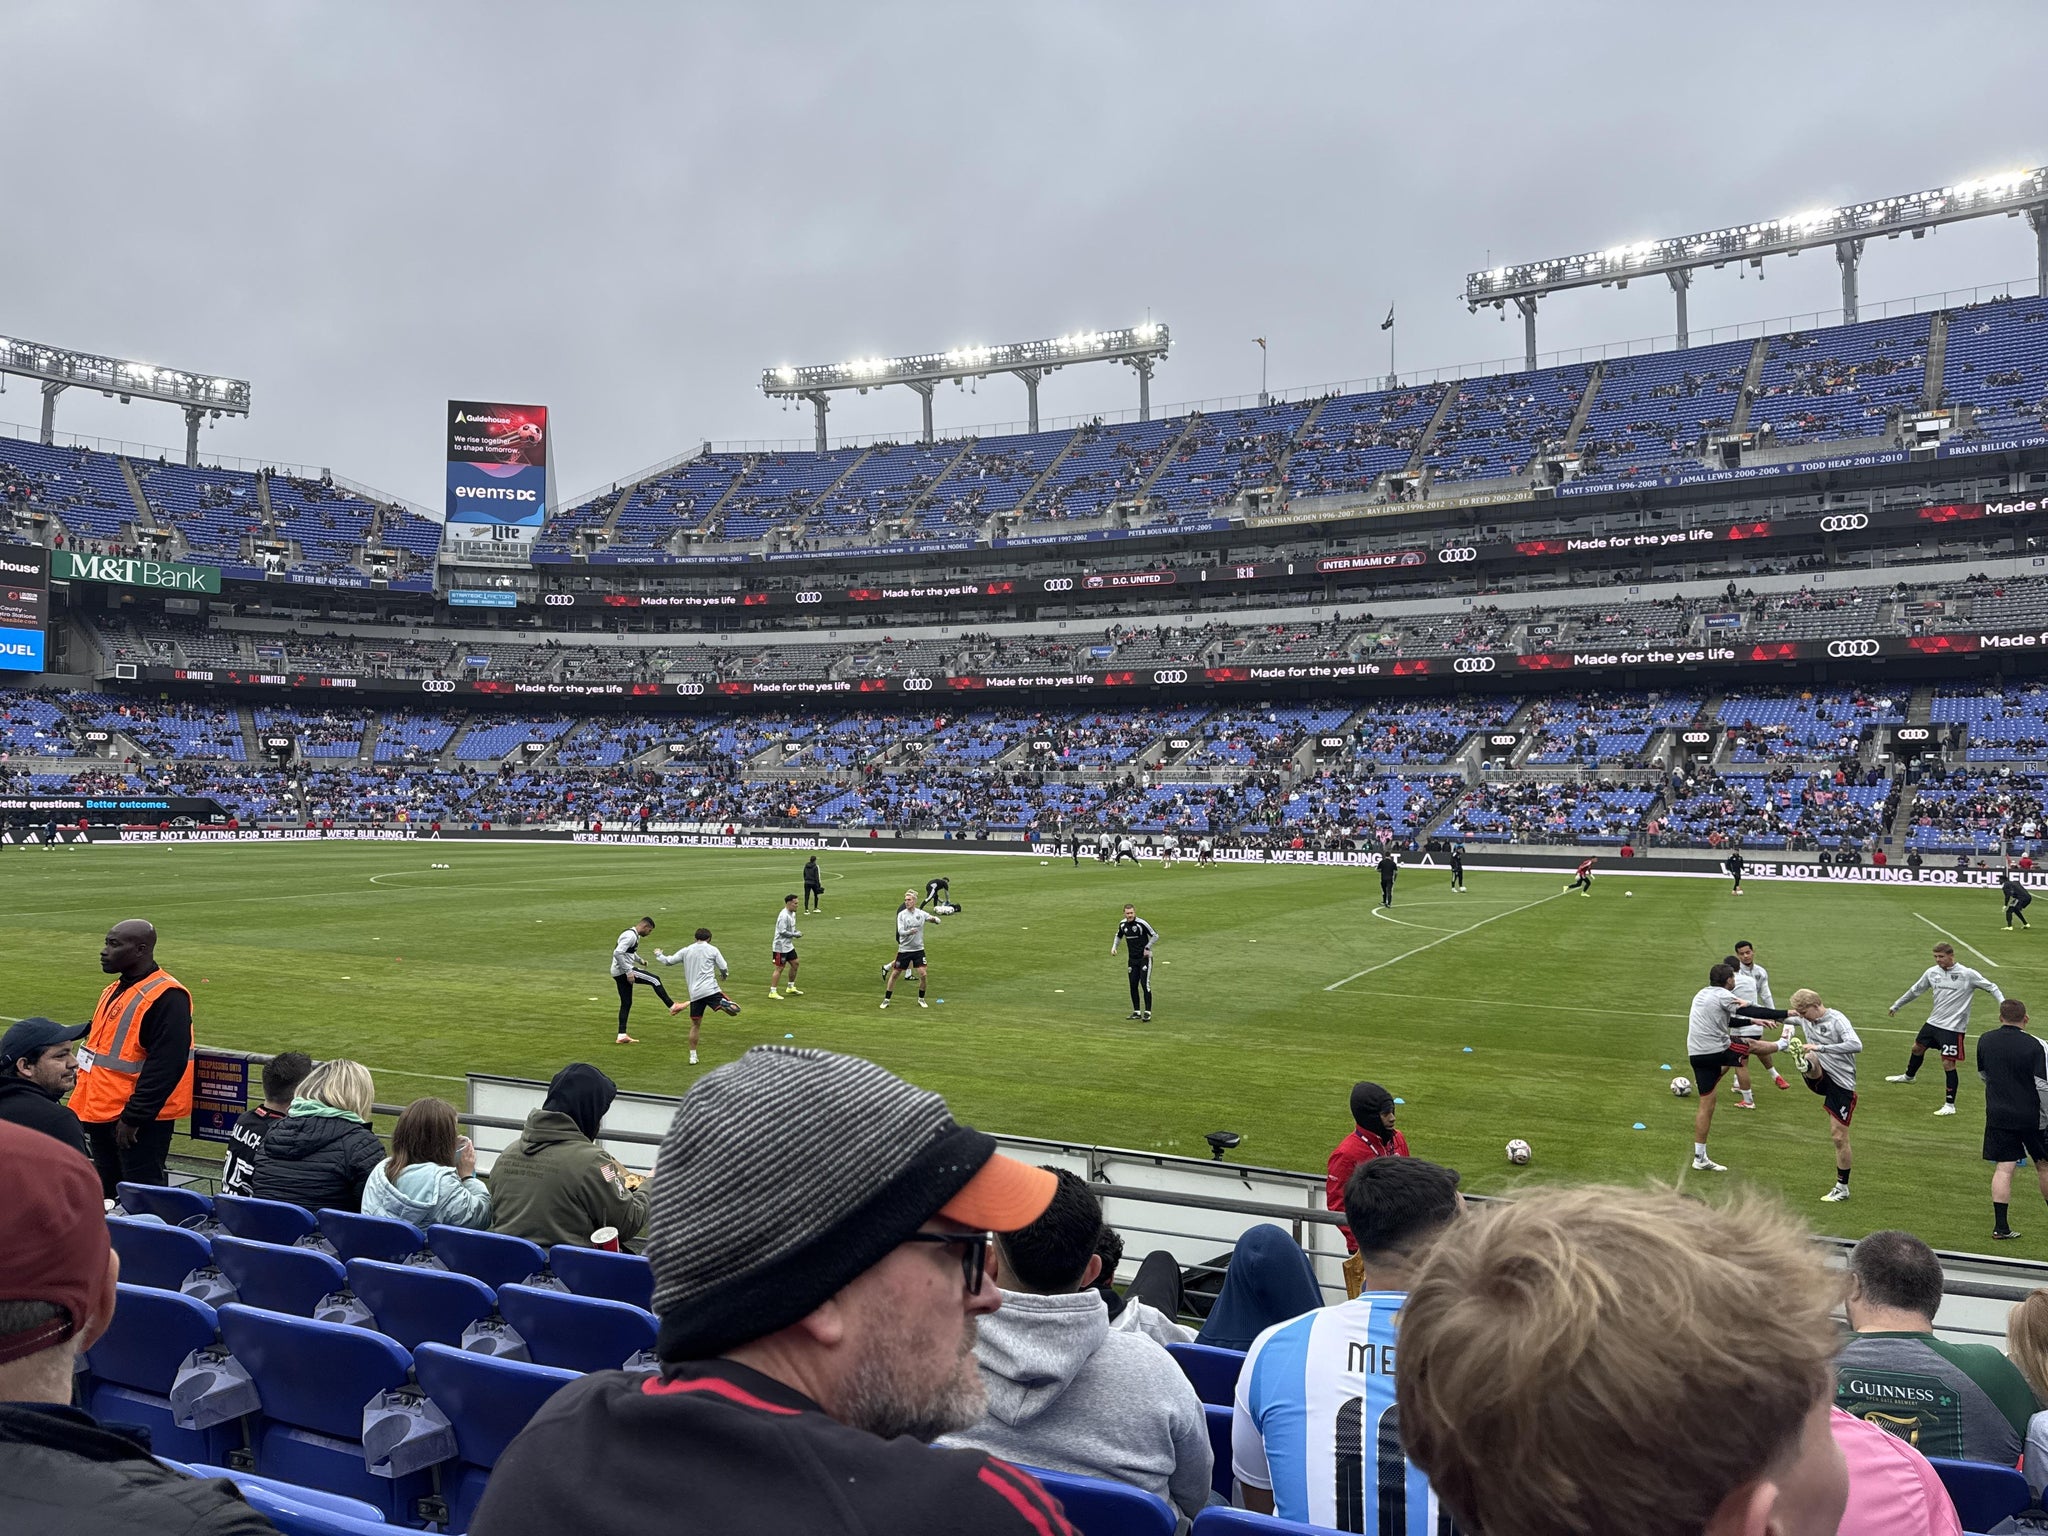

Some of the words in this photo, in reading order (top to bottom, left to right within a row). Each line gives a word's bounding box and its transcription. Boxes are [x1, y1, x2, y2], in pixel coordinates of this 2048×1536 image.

[466, 415, 510, 424] Guidehouse
[1950, 445, 1978, 455] BRIAN
[1981, 440, 2018, 452] BILLICK
[1801, 462, 1826, 471] TODD
[1828, 459, 1852, 469] HEAP
[1854, 454, 1903, 465] 2001-2010
[1679, 476, 1706, 486] JAMAL
[1708, 472, 1732, 481] LEWIS
[1734, 467, 1780, 478] 2000-2006
[1562, 487, 1583, 495] MATT
[1584, 484, 1614, 493] STOVER
[1616, 480, 1658, 490] 1996-2008
[516, 490, 536, 501] DC
[1492, 492, 1533, 502] 2002-2012
[1382, 505, 1404, 514] LEWIS
[1406, 501, 1445, 511] 1996-2012
[1985, 500, 2036, 515] Made
[1257, 516, 1292, 526] JONATHAN
[1293, 514, 1316, 523] OGDEN
[1318, 510, 1354, 520] 1996-2007
[491, 524, 520, 541] Lite
[1147, 527, 1179, 536] BOULWARE
[1180, 524, 1212, 533] 1997-2005
[1568, 540, 1607, 550] Made
[1610, 537, 1631, 547] for
[1634, 535, 1658, 545] the
[1661, 533, 1686, 544] yes
[1690, 529, 1713, 540] life
[70, 553, 140, 583] M&T
[144, 562, 206, 591] Bank
[1130, 575, 1160, 583] UNITED
[1323, 560, 1350, 569] INTER
[1352, 558, 1381, 568] MIAMI
[1383, 556, 1396, 565] CF
[882, 589, 909, 598] Made
[911, 588, 925, 596] for
[926, 587, 942, 596] the
[944, 588, 961, 597] yes
[962, 586, 978, 594] life
[670, 597, 684, 605] for
[685, 597, 702, 605] the
[703, 598, 719, 607] yes
[1981, 634, 2036, 647] Made
[1574, 654, 1616, 665] Made
[1620, 652, 1643, 663] for
[1647, 651, 1674, 662] the
[1677, 652, 1704, 663] yes
[1708, 649, 1735, 660] life
[187, 672, 213, 680] UNITED
[1250, 668, 1286, 678] Made
[1288, 667, 1307, 676] for
[1309, 666, 1331, 676] the
[1333, 667, 1355, 677] yes
[1358, 664, 1380, 674] life
[260, 675, 286, 684] UNITED
[332, 678, 356, 687] UNITED
[986, 677, 1016, 686] Made
[1018, 677, 1034, 685] for
[1035, 676, 1054, 685] the
[1055, 678, 1074, 686] yes
[1076, 675, 1094, 684] life
[515, 684, 546, 692] Made
[548, 684, 564, 693] for
[566, 685, 584, 693] the
[585, 686, 604, 694] yes
[606, 685, 623, 693] life
[754, 683, 780, 692] Made
[782, 683, 797, 691] for
[816, 685, 832, 693] yes
[30, 801, 83, 810] questions.
[86, 800, 116, 809] Better
[120, 832, 157, 841] WE'RE
[160, 831, 184, 841] NOT
[188, 830, 236, 840] WAITING
[239, 830, 259, 839] FOR
[262, 830, 281, 839] THE
[284, 830, 321, 839] FUTURE
[326, 830, 354, 839] WE'RE
[358, 830, 404, 839] BUILDING
[572, 833, 598, 842] WE'RE
[601, 834, 619, 842] NOT
[621, 835, 659, 844] WAITING
[661, 835, 678, 844] FOR
[680, 836, 698, 845] THE
[701, 836, 736, 846] FUTURE
[740, 837, 769, 846] WE'RE
[772, 838, 815, 847] BUILDING
[1156, 846, 1180, 857] FR
[1213, 848, 1263, 860] FUTURE
[1271, 850, 1313, 861] WE'RE
[1318, 851, 1382, 863] BUILDING
[1782, 865, 1822, 878] NOT
[1827, 866, 1912, 881] WAITING
[1918, 869, 1960, 883] FOR
[1964, 870, 2003, 884] THE
[1942, 1044, 1958, 1055] 25
[1840, 1106, 1848, 1120] 4
